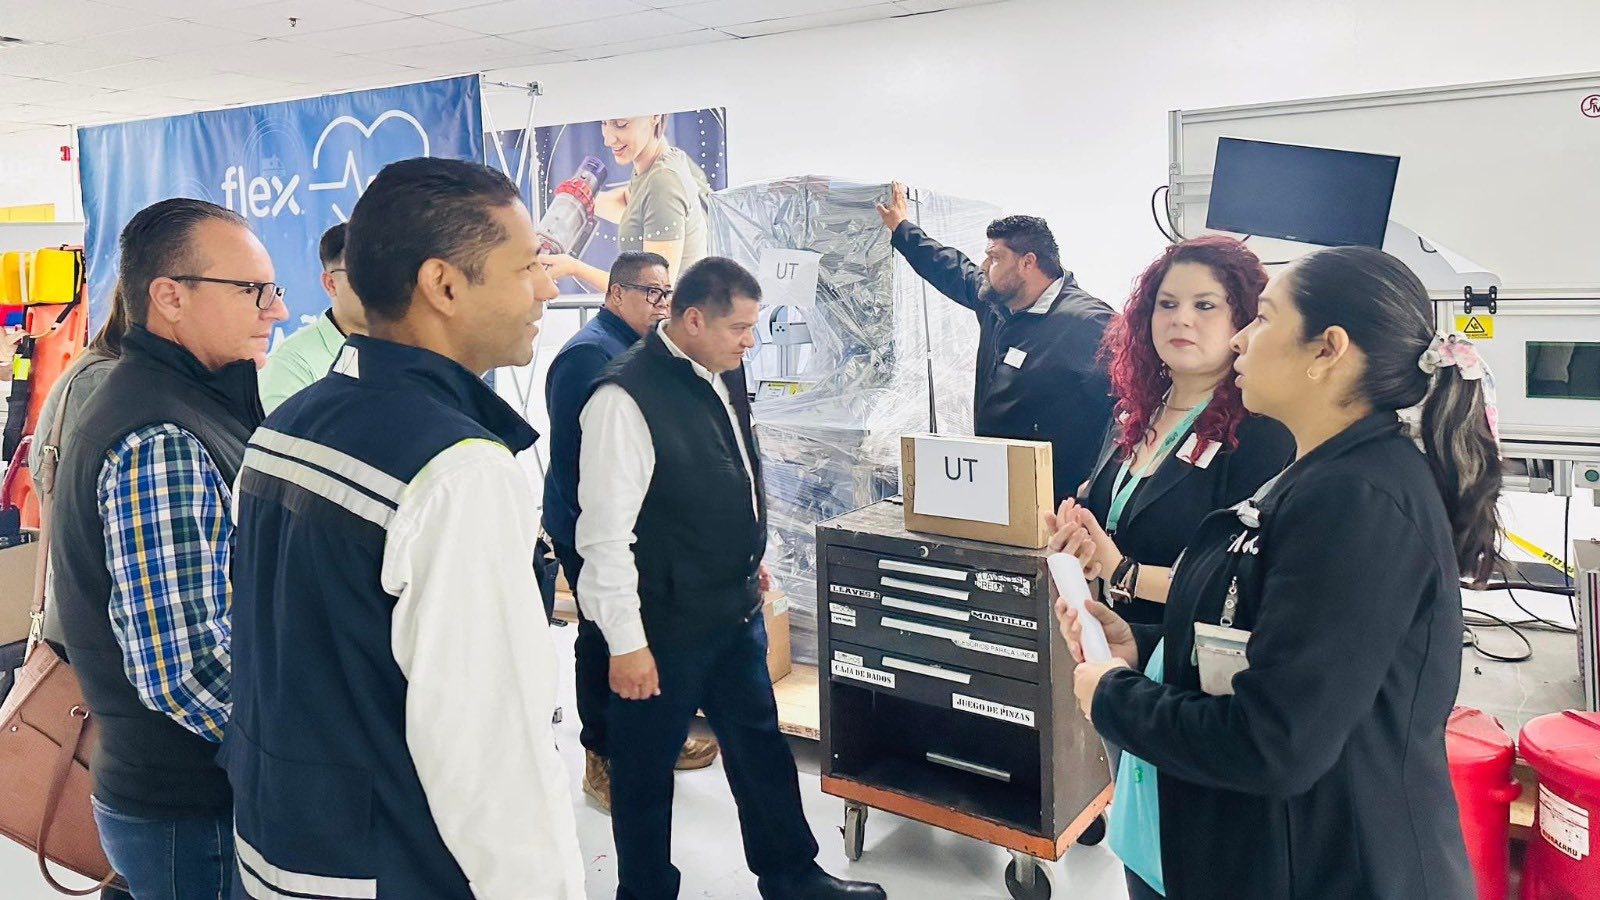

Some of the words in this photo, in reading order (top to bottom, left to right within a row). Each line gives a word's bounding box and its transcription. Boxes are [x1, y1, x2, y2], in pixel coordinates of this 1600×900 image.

[221, 165, 302, 218] flex
[776, 262, 799, 280] UT
[944, 456, 978, 482] UT
[832, 586, 872, 597] LLAVES
[972, 611, 1034, 628] MARTILLO
[835, 664, 854, 675] CAJA
[855, 669, 865, 678] DE
[866, 671, 892, 684] DADOS
[956, 698, 985, 711] JUEGO
[987, 705, 999, 715] DE
[1000, 708, 1030, 722] PINZAS
